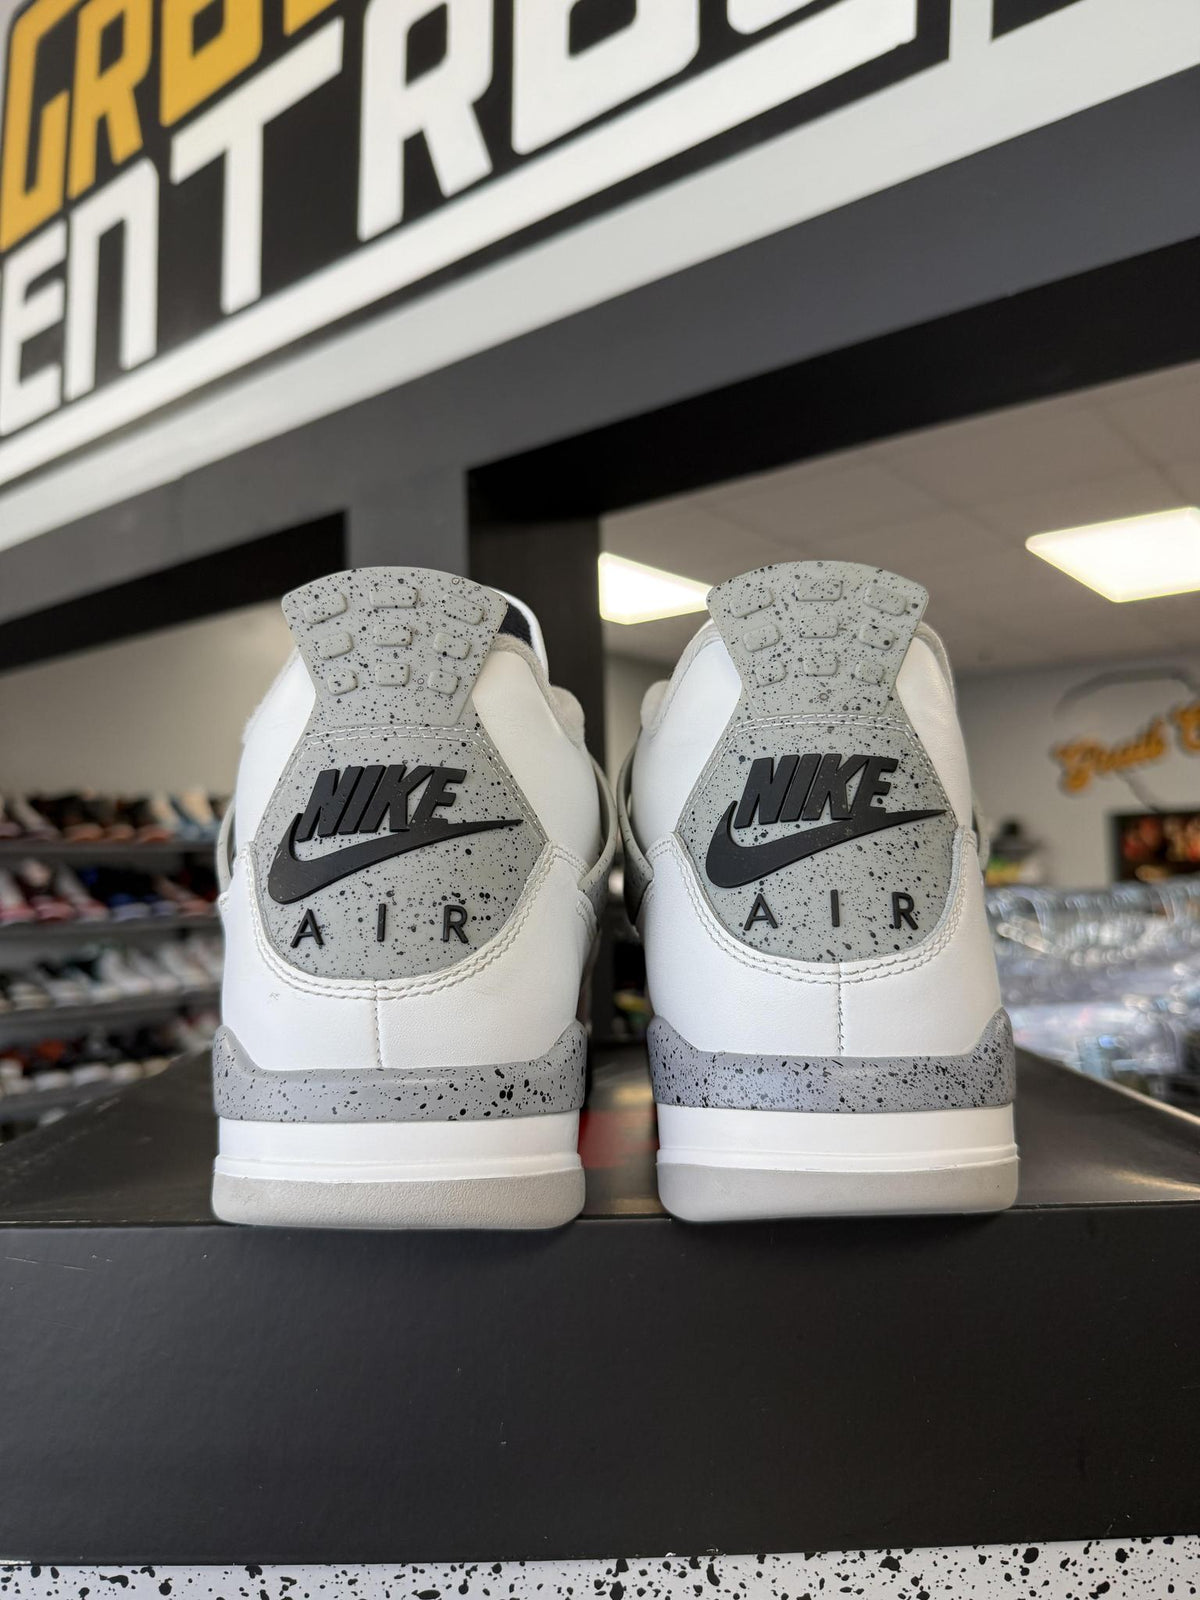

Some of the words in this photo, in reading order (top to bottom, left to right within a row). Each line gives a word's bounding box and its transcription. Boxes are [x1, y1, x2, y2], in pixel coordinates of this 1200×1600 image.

[296, 764, 468, 842] NIKE
[734, 753, 899, 829] NIKE
[290, 903, 469, 948] AIR
[743, 889, 918, 931] AIR
